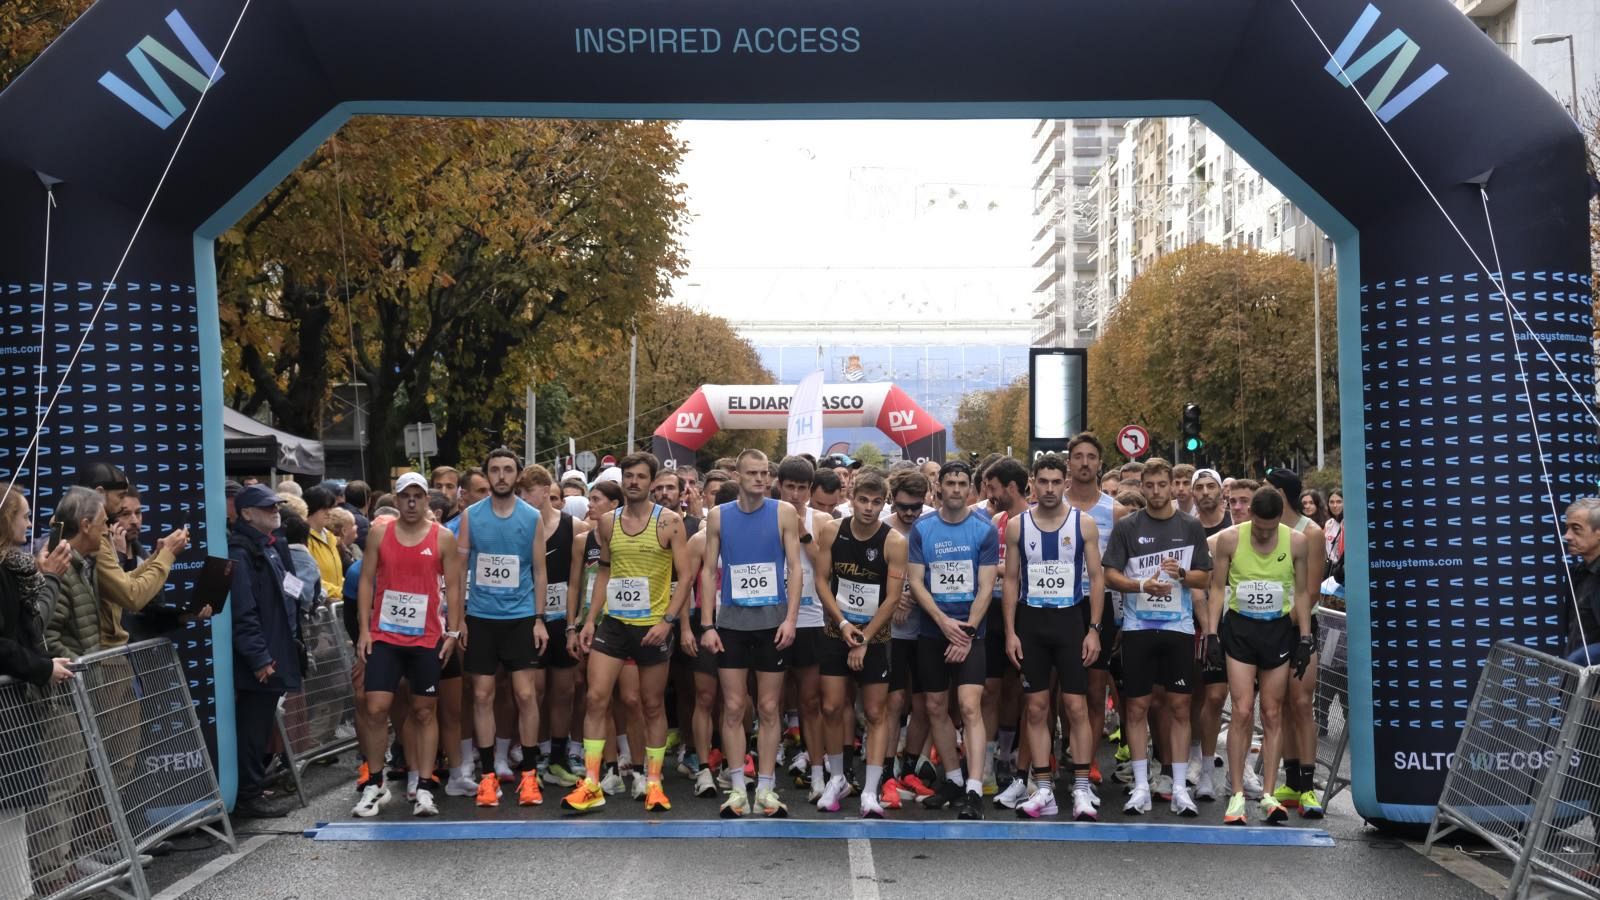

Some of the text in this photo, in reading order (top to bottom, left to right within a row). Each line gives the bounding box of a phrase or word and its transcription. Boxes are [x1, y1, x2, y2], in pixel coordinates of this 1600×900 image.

[575, 27, 861, 53] INSPIRED ACCESS
[1514, 331, 1588, 343] saltosystems.com
[728, 396, 747, 410] EL
[822, 395, 863, 410] ASCO
[676, 412, 703, 428] DV
[888, 410, 915, 426] DV
[934, 541, 953, 549] SALTO
[935, 545, 971, 555] FOUNDATION
[1370, 558, 1463, 570] saltosystems.com
[484, 567, 510, 579] 340
[939, 573, 965, 585] 244
[740, 576, 768, 589] 206
[1036, 577, 1065, 589] 409
[548, 595, 561, 607] 21
[615, 590, 641, 601] 402
[848, 594, 865, 607] 50
[1247, 593, 1273, 605] 252
[391, 605, 417, 619] 342
